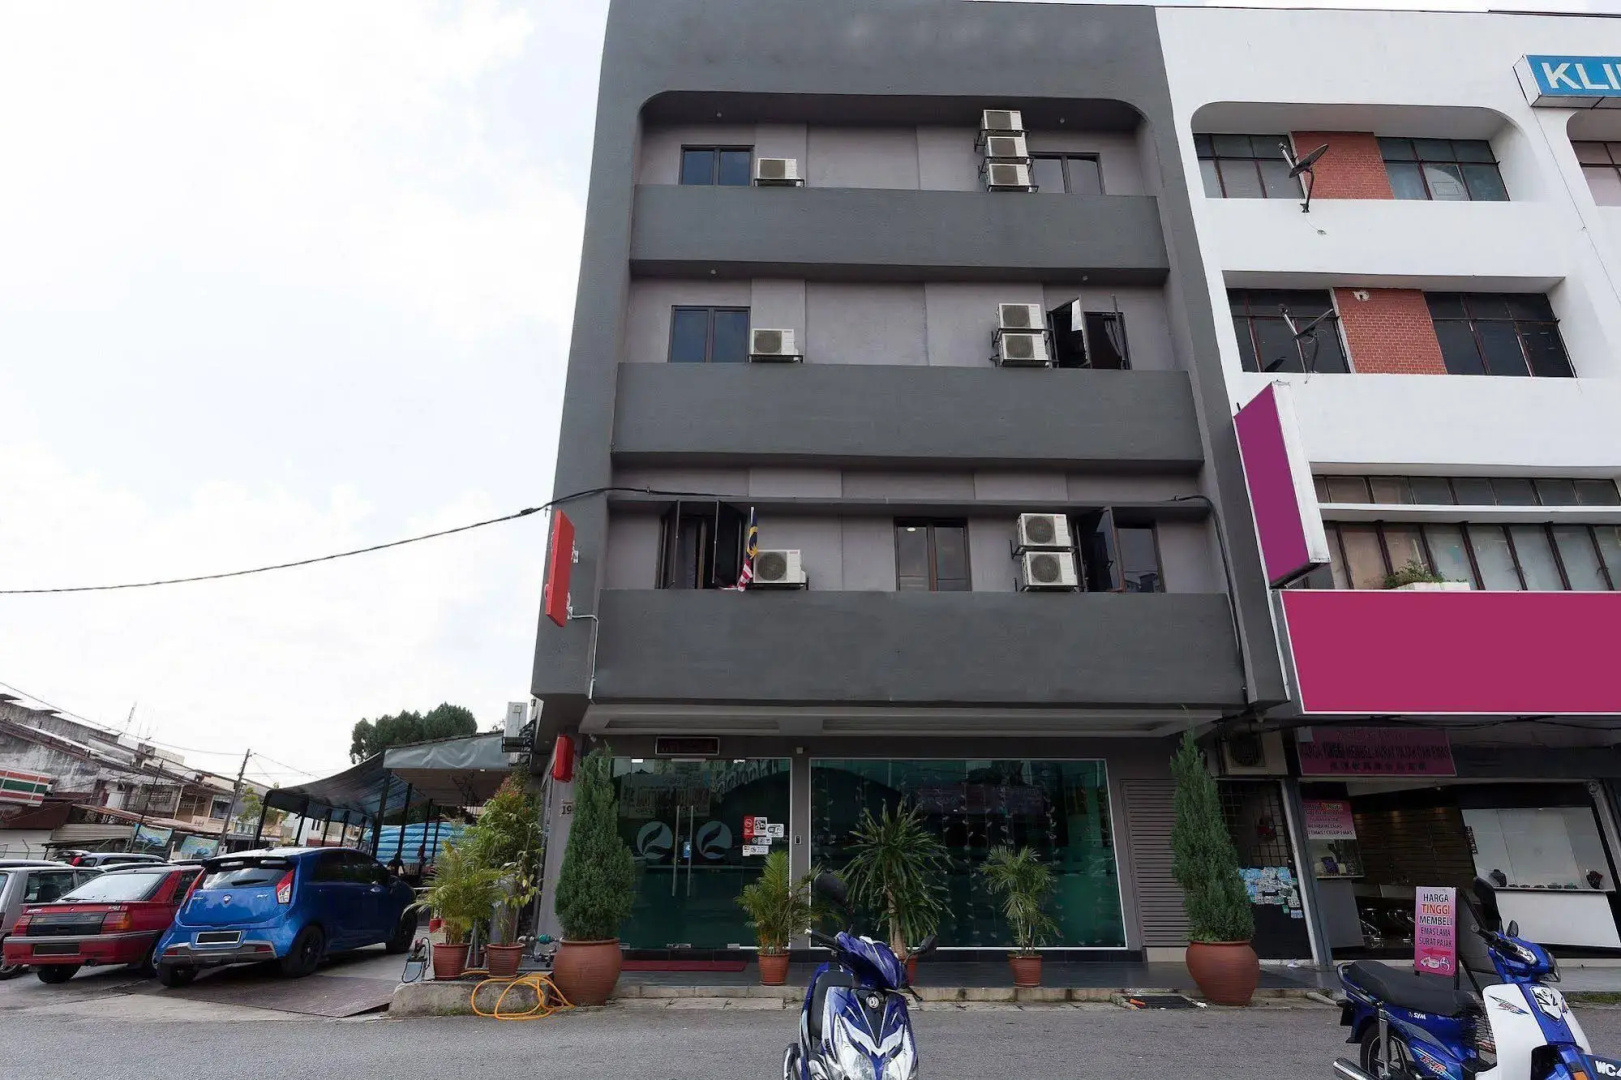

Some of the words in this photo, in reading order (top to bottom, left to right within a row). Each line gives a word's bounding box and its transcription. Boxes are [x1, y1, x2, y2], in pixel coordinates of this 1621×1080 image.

[1541, 62, 1621, 90] KLI
[1423, 893, 1449, 903] HARGA
[1421, 903, 1450, 915] TINGGI
[1419, 915, 1453, 926] MEMBELI
[1420, 926, 1436, 936] EMAS
[1436, 927, 1451, 937] LAMA
[1419, 936, 1436, 946] SURAT
[1437, 938, 1453, 948] PAJAK
